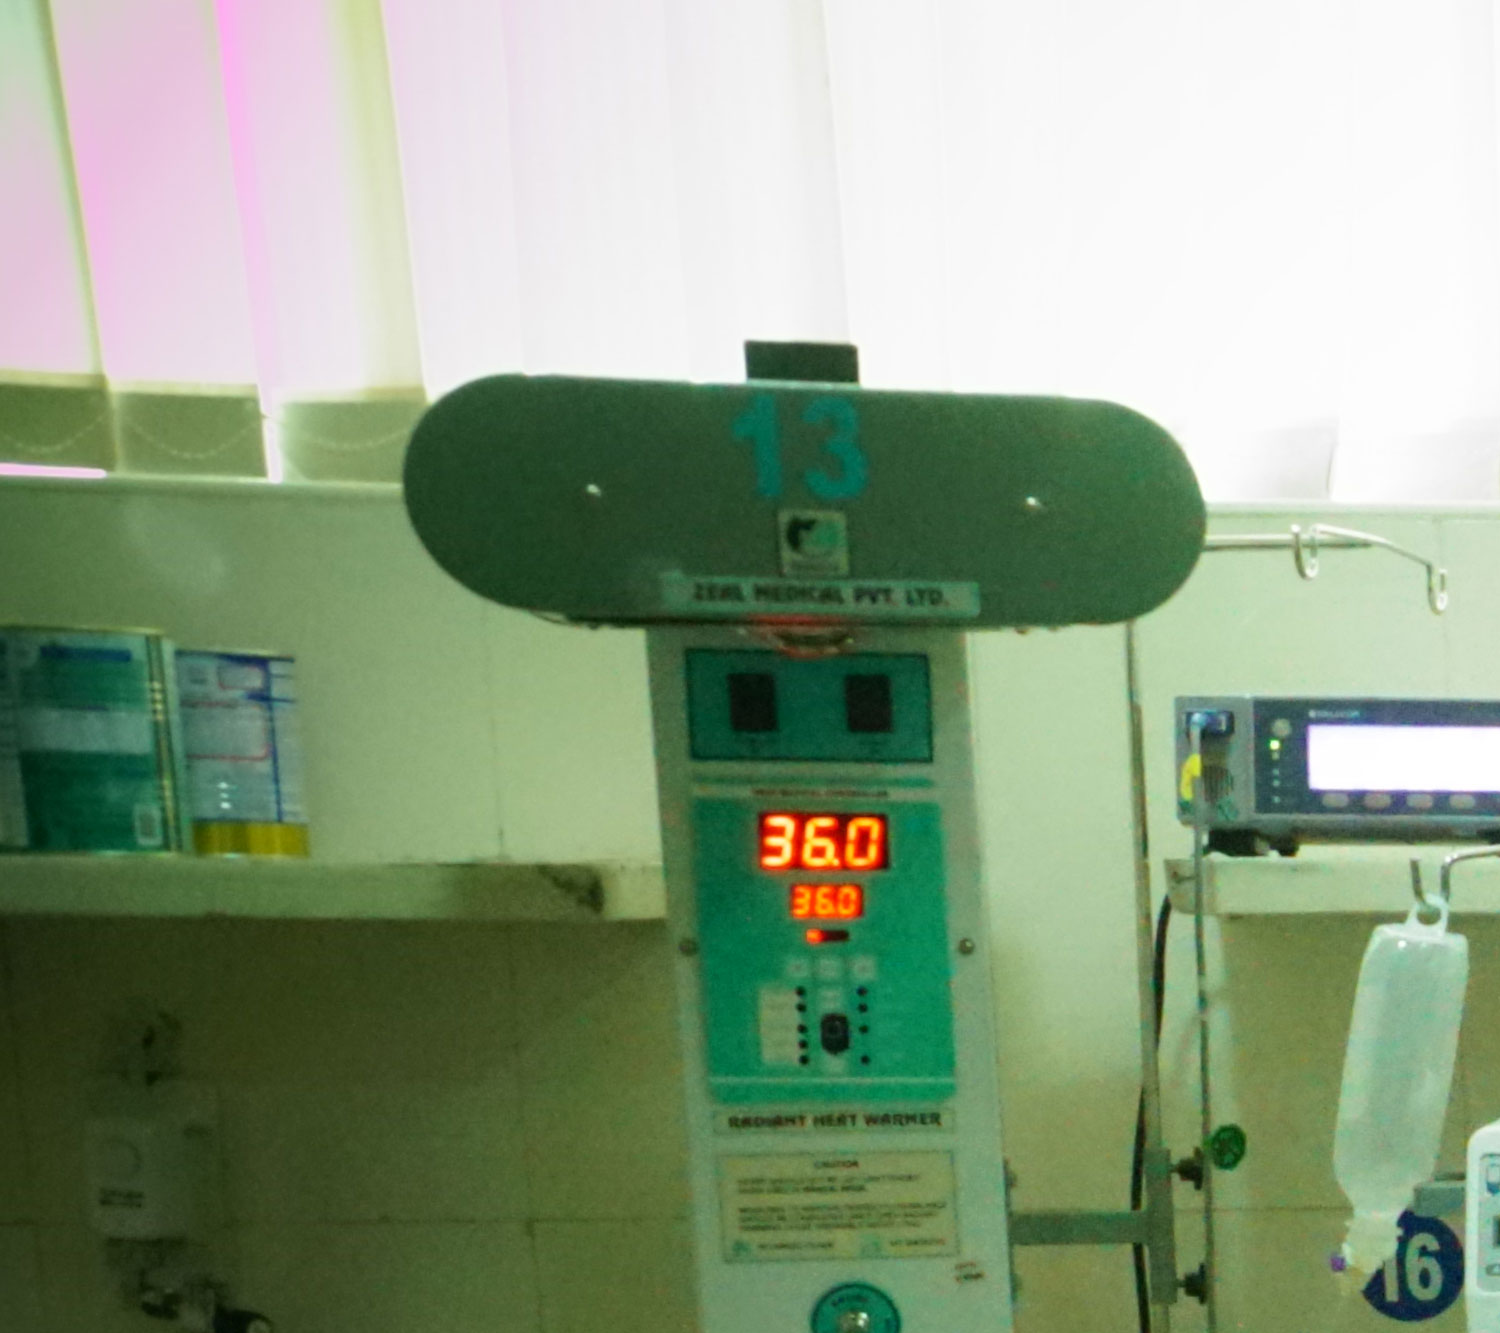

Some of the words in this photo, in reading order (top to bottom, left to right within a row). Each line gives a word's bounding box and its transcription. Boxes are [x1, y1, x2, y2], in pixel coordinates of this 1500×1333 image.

[731, 393, 869, 499] 13
[813, 1113, 857, 1127] HEAT
[863, 1111, 942, 1127] WARMER
